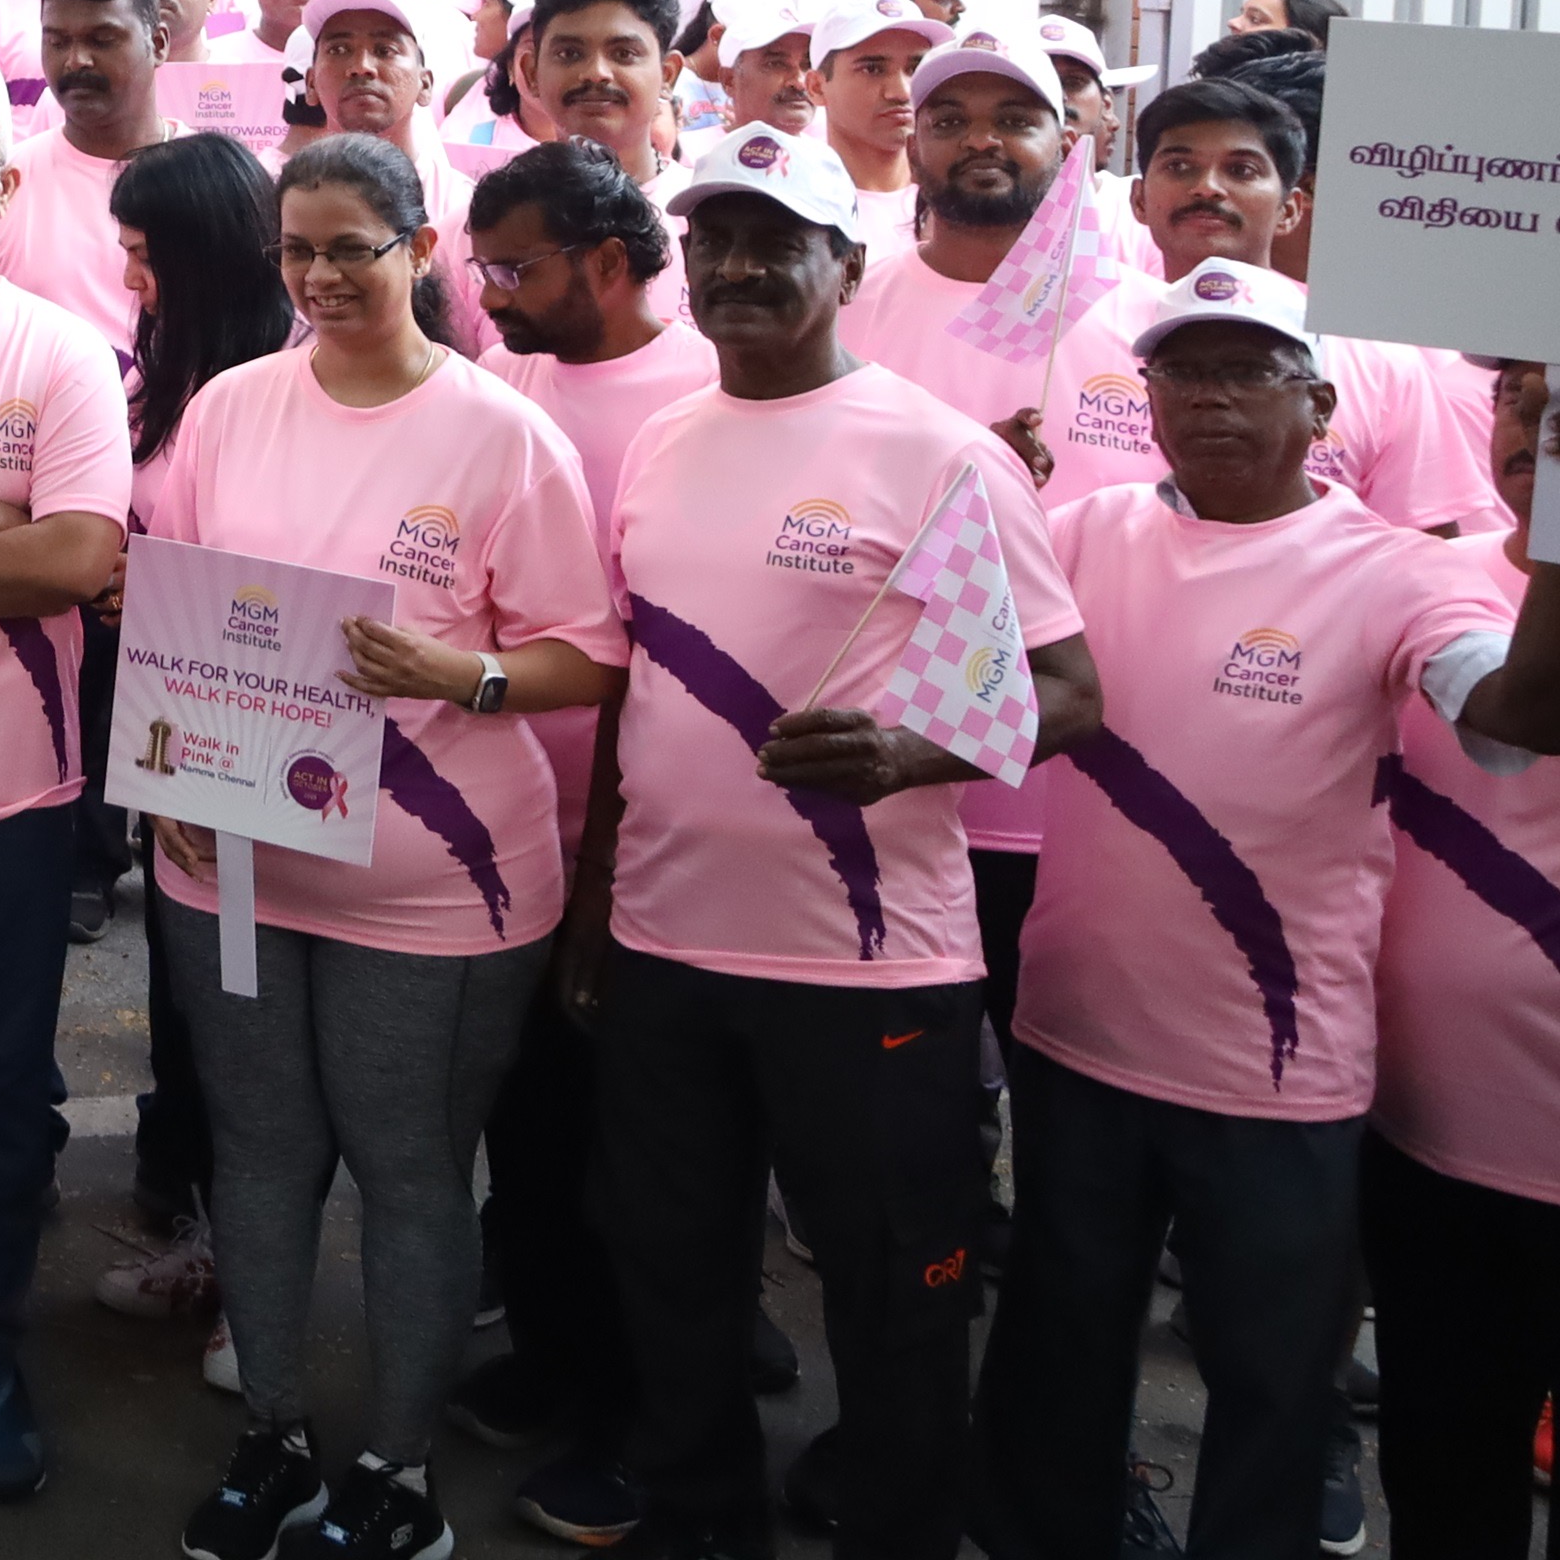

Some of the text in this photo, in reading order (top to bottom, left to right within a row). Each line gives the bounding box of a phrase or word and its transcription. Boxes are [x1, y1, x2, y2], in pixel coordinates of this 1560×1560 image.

[197, 102, 233, 110] Cancer
[198, 91, 232, 101] MGM
[195, 110, 236, 119] Institute
[223, 125, 289, 137] TOWARDS
[1378, 196, 1540, 233] விதியை
[1079, 392, 1150, 420] MGM
[1075, 412, 1149, 436] Cancer
[1068, 427, 1152, 454] Institute
[397, 519, 460, 555] MGM
[782, 514, 852, 540] MGM
[775, 534, 849, 556] Cancer
[766, 550, 855, 574] Institute
[231, 599, 279, 624] MGM
[227, 615, 279, 638] Cancer
[222, 628, 282, 652] Institute
[1230, 642, 1302, 670] MGM
[127, 647, 376, 718] WALK FOR YOUR HEALTH,
[976, 647, 1011, 703] MGM
[1223, 663, 1300, 687] Cancer
[164, 676, 332, 729] WALK FOR HOPE!
[1213, 677, 1304, 705] Institute
[182, 731, 240, 756] Walk in
[181, 747, 214, 766] Pink
[179, 763, 257, 788] Namma Chennai
[293, 770, 328, 786] ACT IN
